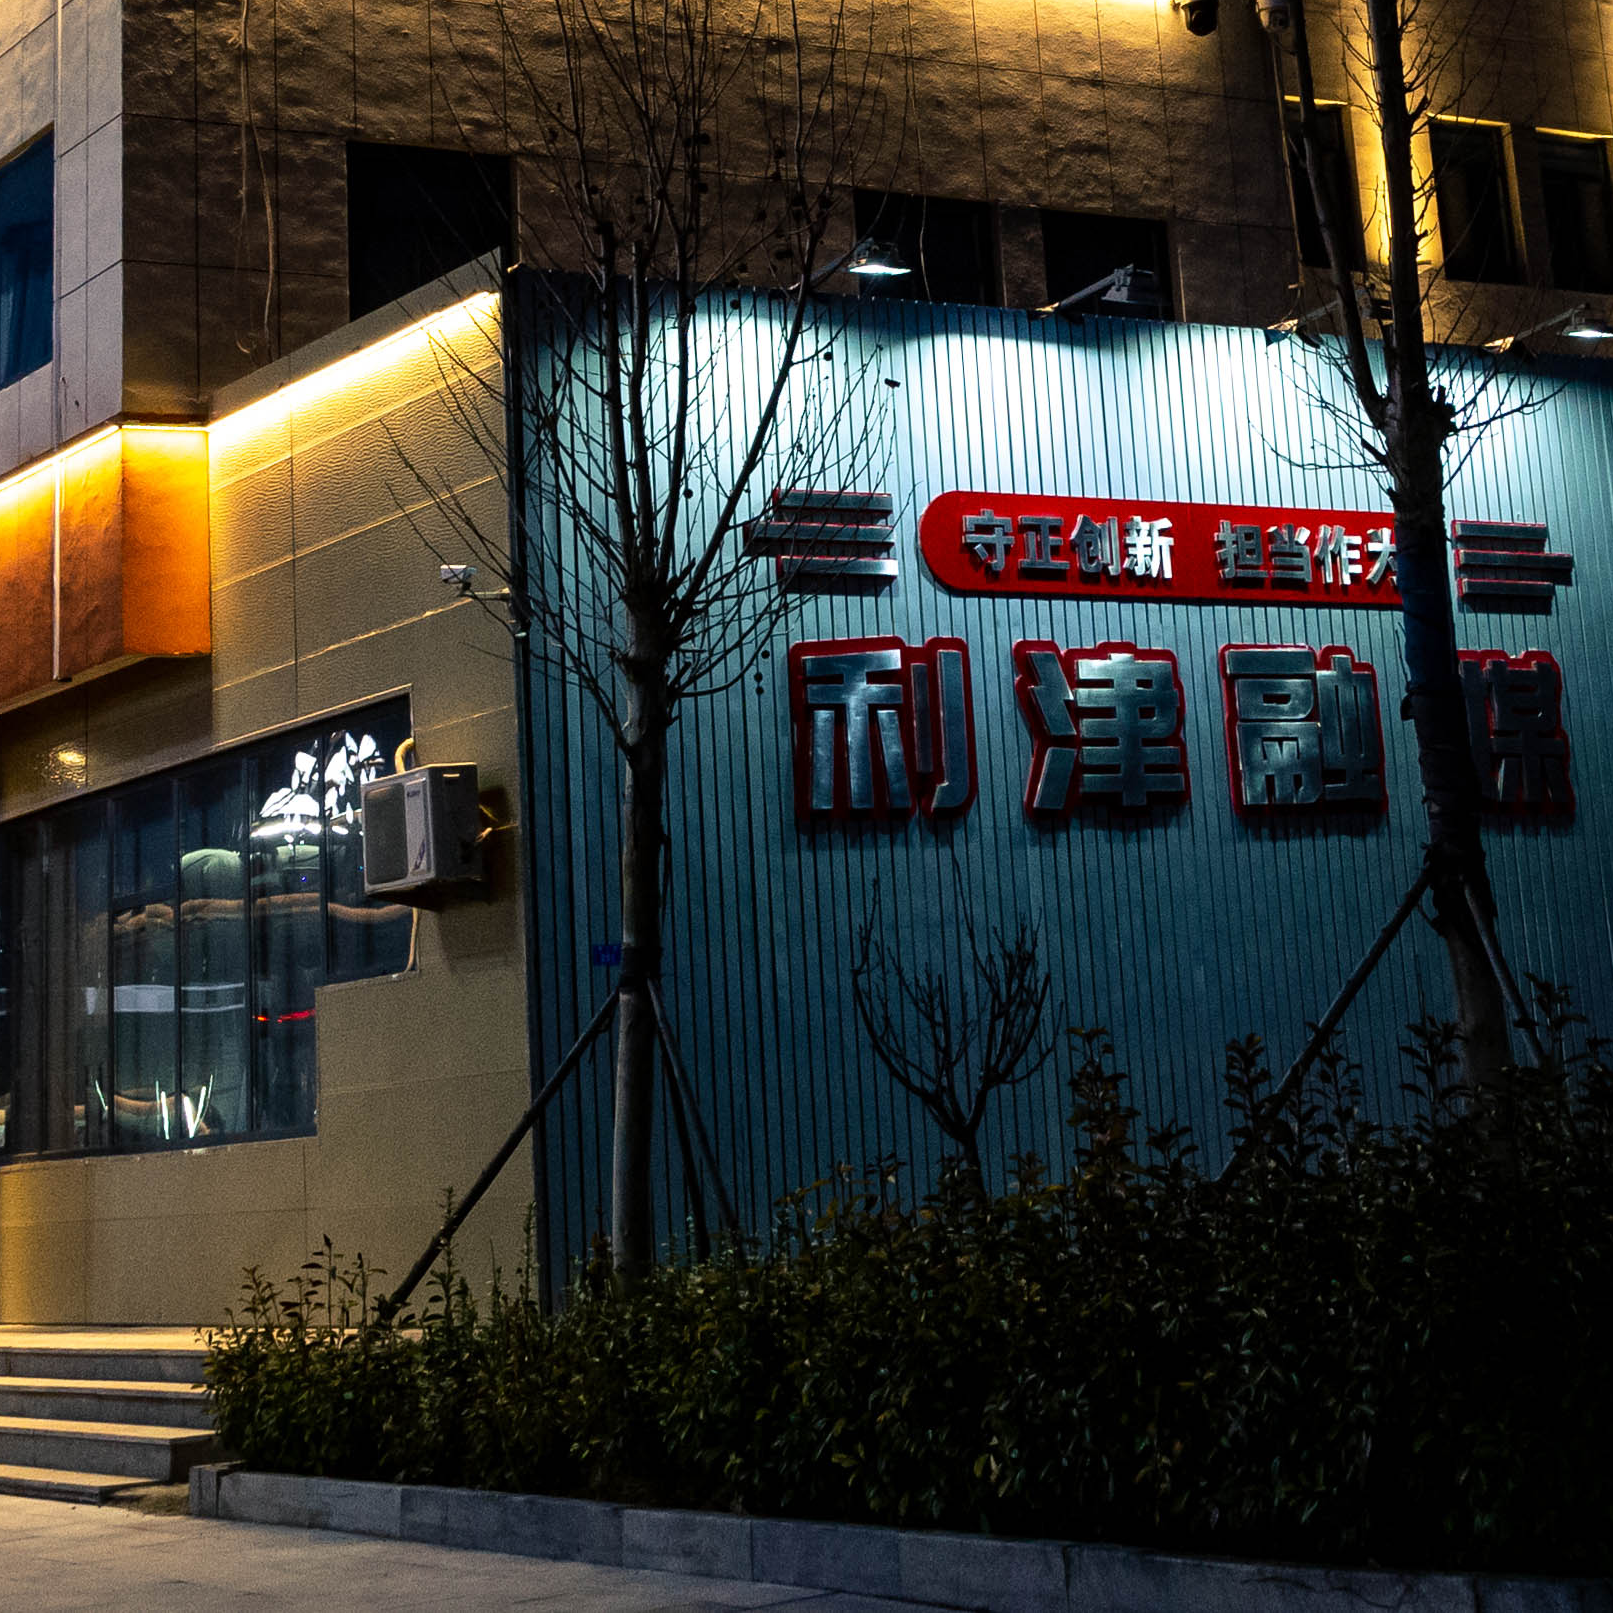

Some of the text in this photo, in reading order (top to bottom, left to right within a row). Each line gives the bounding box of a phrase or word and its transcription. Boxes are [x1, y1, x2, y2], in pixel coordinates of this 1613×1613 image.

[962, 508, 1174, 579] 守正创新
[800, 648, 1566, 810] 利津融媒
